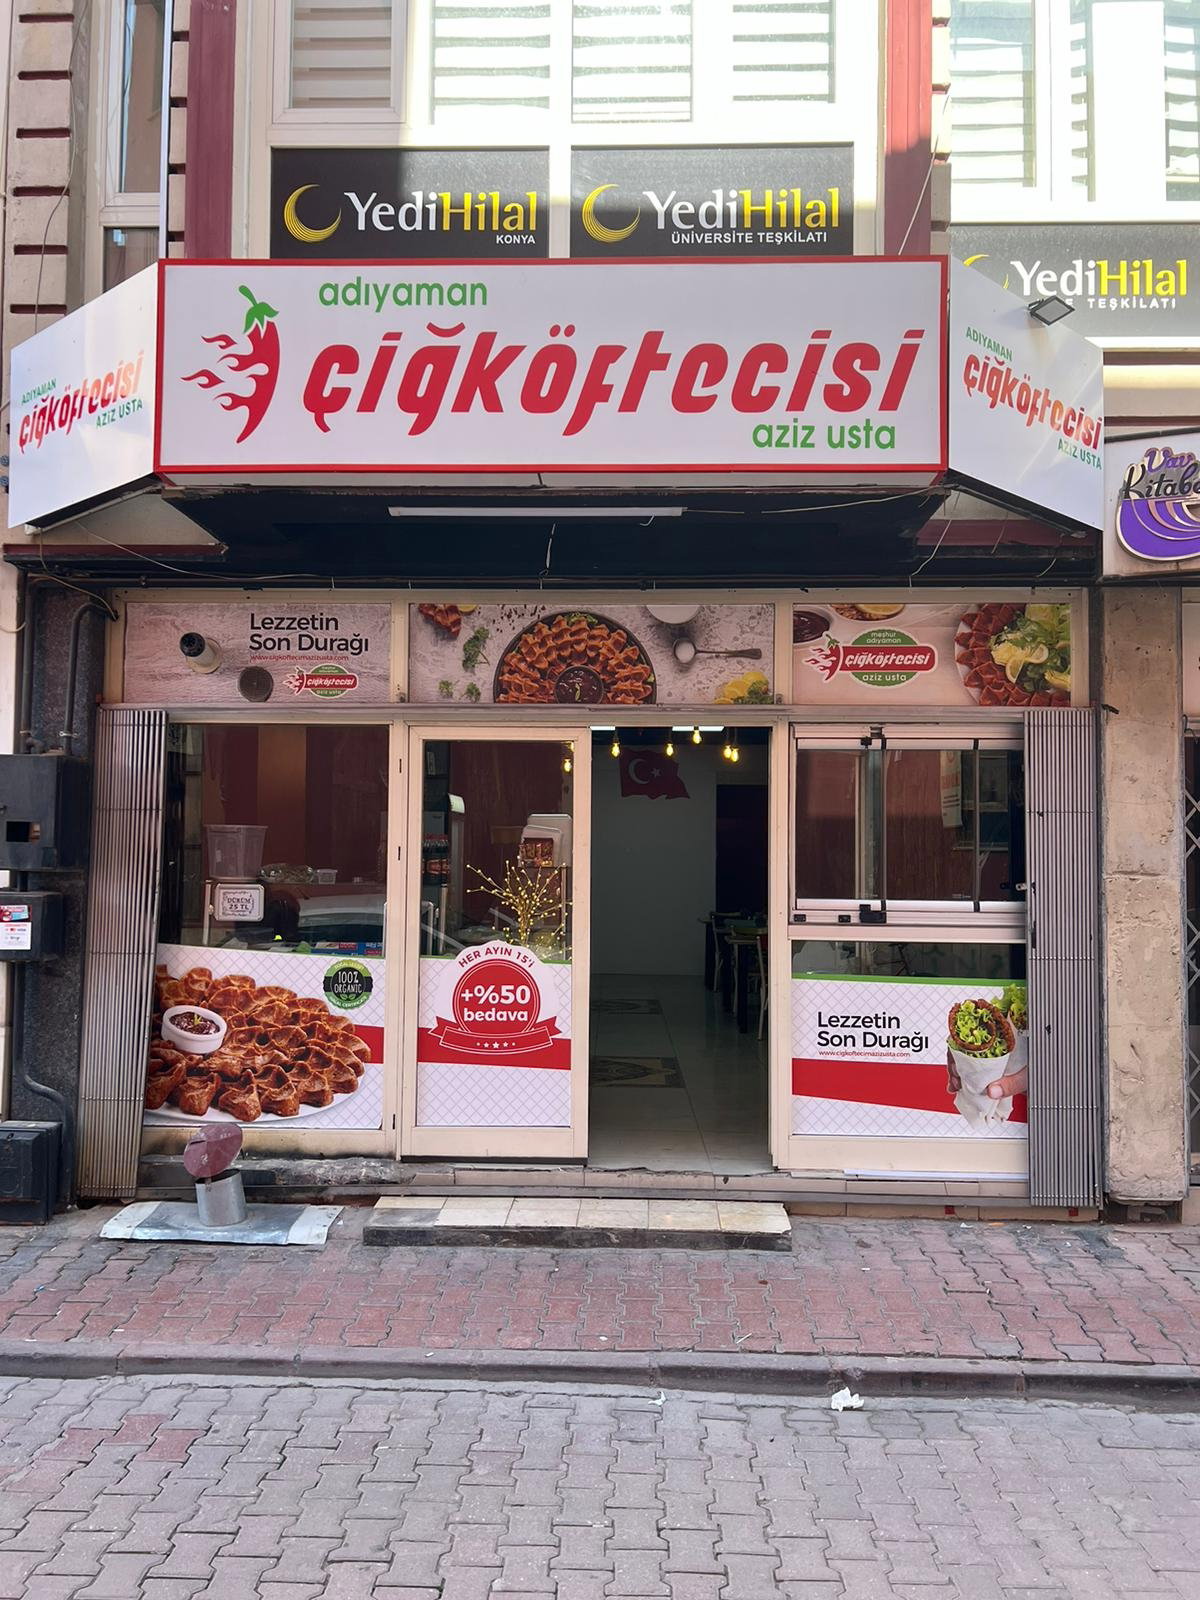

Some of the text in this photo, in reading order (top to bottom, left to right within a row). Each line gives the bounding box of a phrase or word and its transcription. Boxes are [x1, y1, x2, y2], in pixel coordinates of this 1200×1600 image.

[344, 191, 537, 231] YediHilal
[642, 187, 839, 230] YediHilal
[496, 234, 536, 244] KONYA
[671, 230, 828, 245] ÜNİVERSİTE TEŞKİLATI
[1010, 259, 1188, 297] YediHilal
[319, 276, 488, 313] adıyaman
[1088, 296, 1177, 311] TEŞKİLATI
[966, 327, 1013, 362] ADIYAMAN
[303, 321, 925, 437] çiğköftecisi
[21, 378, 57, 405] ADIYAMAN
[118, 397, 143, 419] USTA
[752, 419, 896, 449] aziz usta
[1058, 437, 1103, 470] AZİZ USTA
[250, 612, 339, 631] Lezzetin
[249, 633, 369, 656] Son Durağı
[862, 673, 907, 681] aziz usta
[458, 950, 481, 968] HER
[484, 946, 513, 957] AYIN
[334, 984, 363, 994] ORGANIC
[461, 984, 531, 1005] +%50
[463, 1007, 528, 1022] bedava
[818, 1011, 901, 1029] Lezzetin
[817, 1030, 929, 1053] Son Durağı
